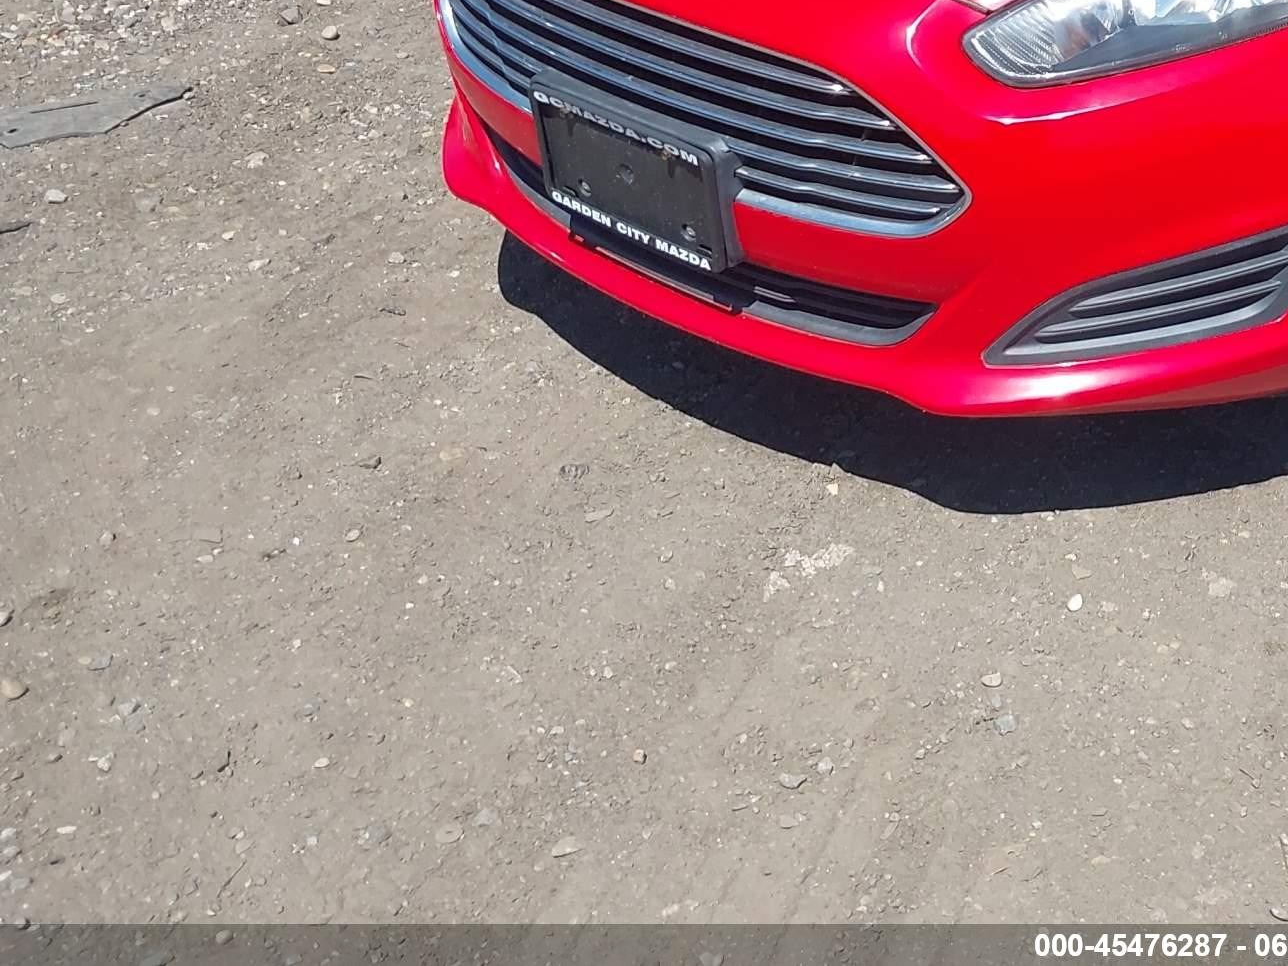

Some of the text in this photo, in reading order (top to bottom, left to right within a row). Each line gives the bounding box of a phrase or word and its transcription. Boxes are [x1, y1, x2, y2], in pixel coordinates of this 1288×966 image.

[533, 90, 699, 166] GCMAZDA.COM
[551, 191, 712, 271] GARDEN CITY MAZDA
